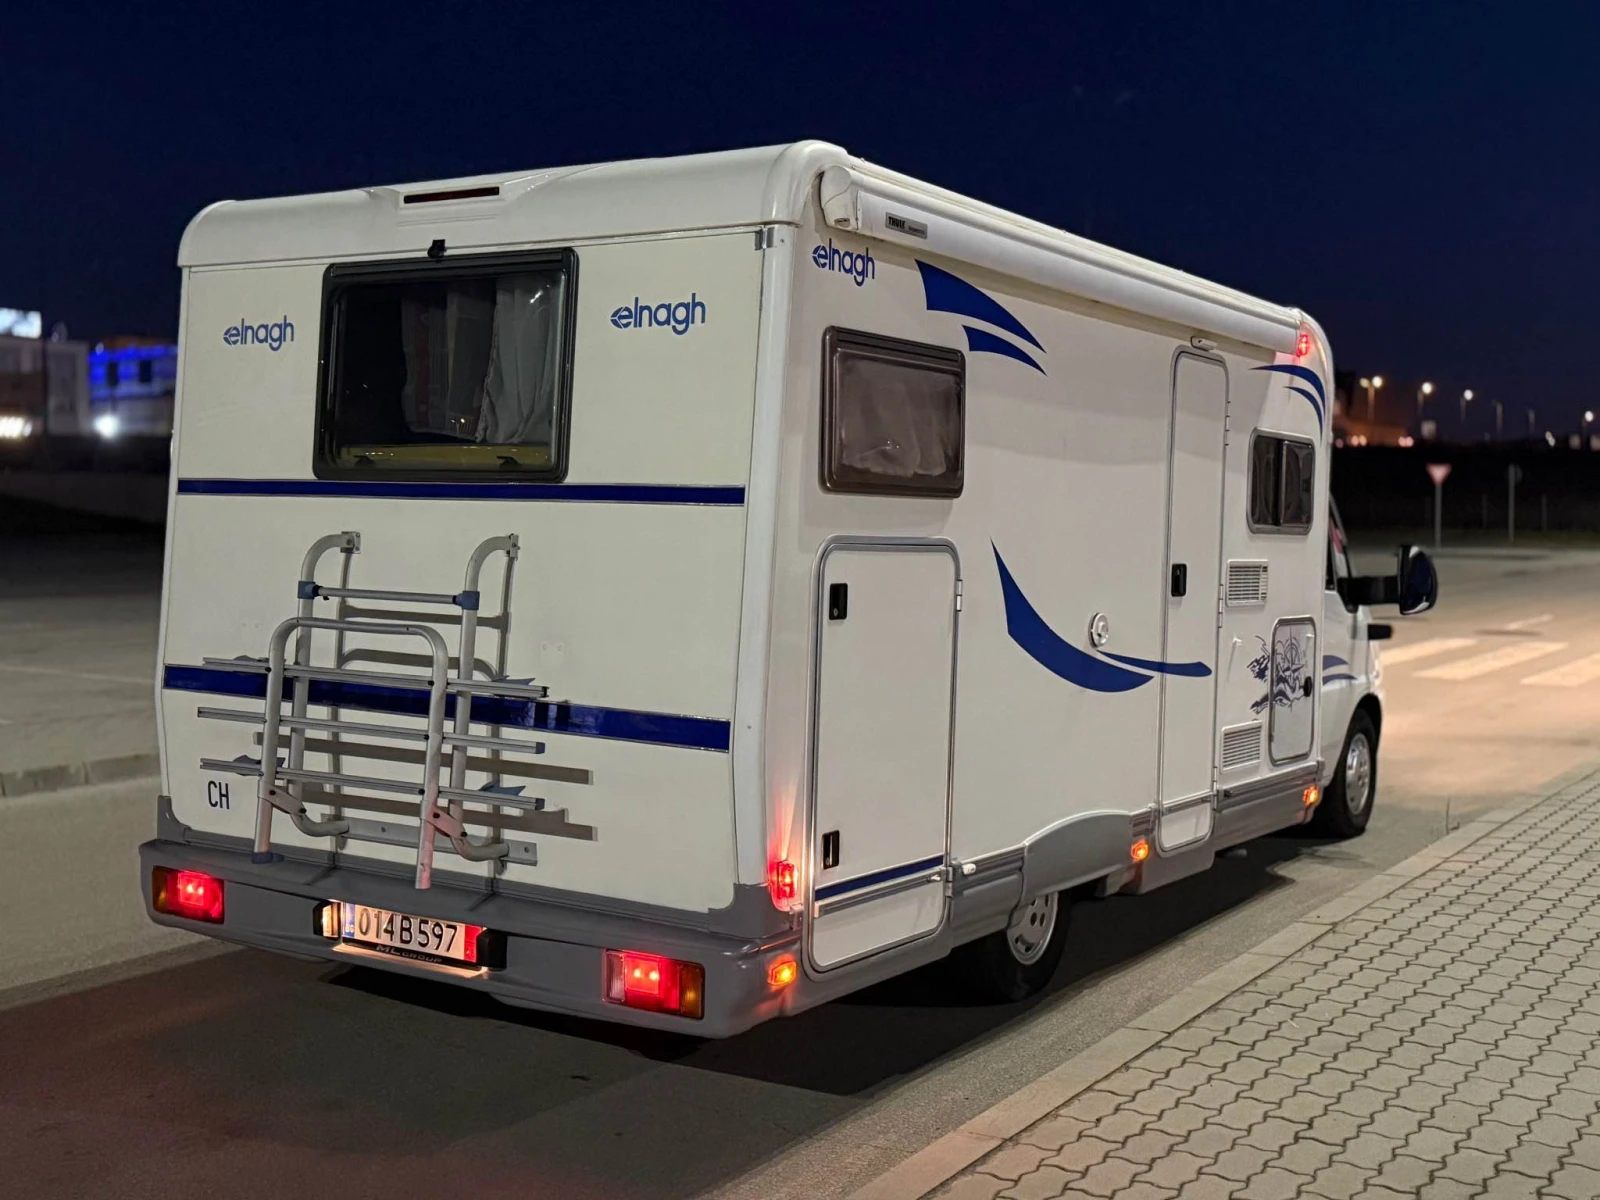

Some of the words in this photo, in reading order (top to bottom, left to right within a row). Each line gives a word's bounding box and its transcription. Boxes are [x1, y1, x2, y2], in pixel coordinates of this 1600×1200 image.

[811, 238, 876, 287] elnagh
[223, 314, 295, 352] elnagh
[610, 292, 706, 336] elnagh
[207, 780, 230, 810] CH
